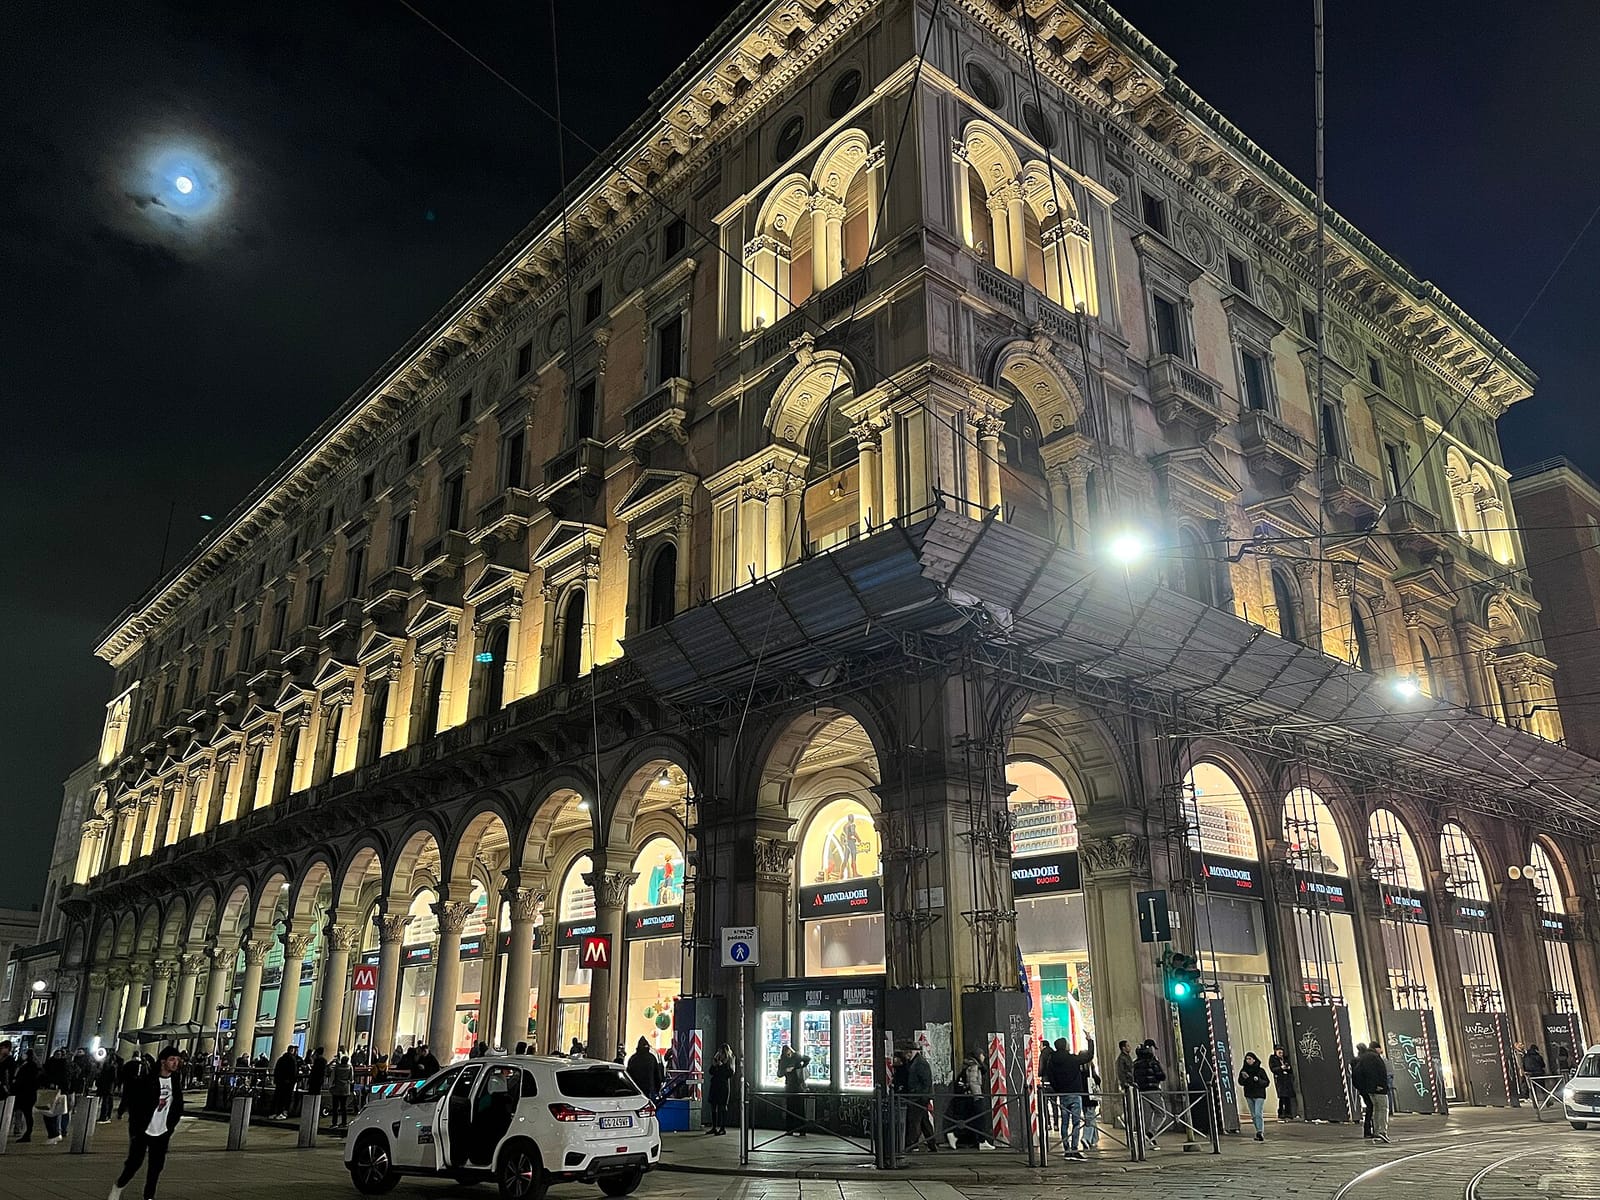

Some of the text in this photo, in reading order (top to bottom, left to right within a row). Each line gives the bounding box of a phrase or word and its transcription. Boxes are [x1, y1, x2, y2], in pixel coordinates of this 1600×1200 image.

[1011, 865, 1060, 880] ONDADORI
[1036, 875, 1060, 885] DUOMO
[823, 889, 869, 903] MONDADORI
[584, 942, 608, 962] M
[355, 970, 374, 985] M
[762, 991, 789, 1002] SOUVENIR
[805, 990, 823, 1001] POINT
[843, 988, 866, 1000] MILANO
